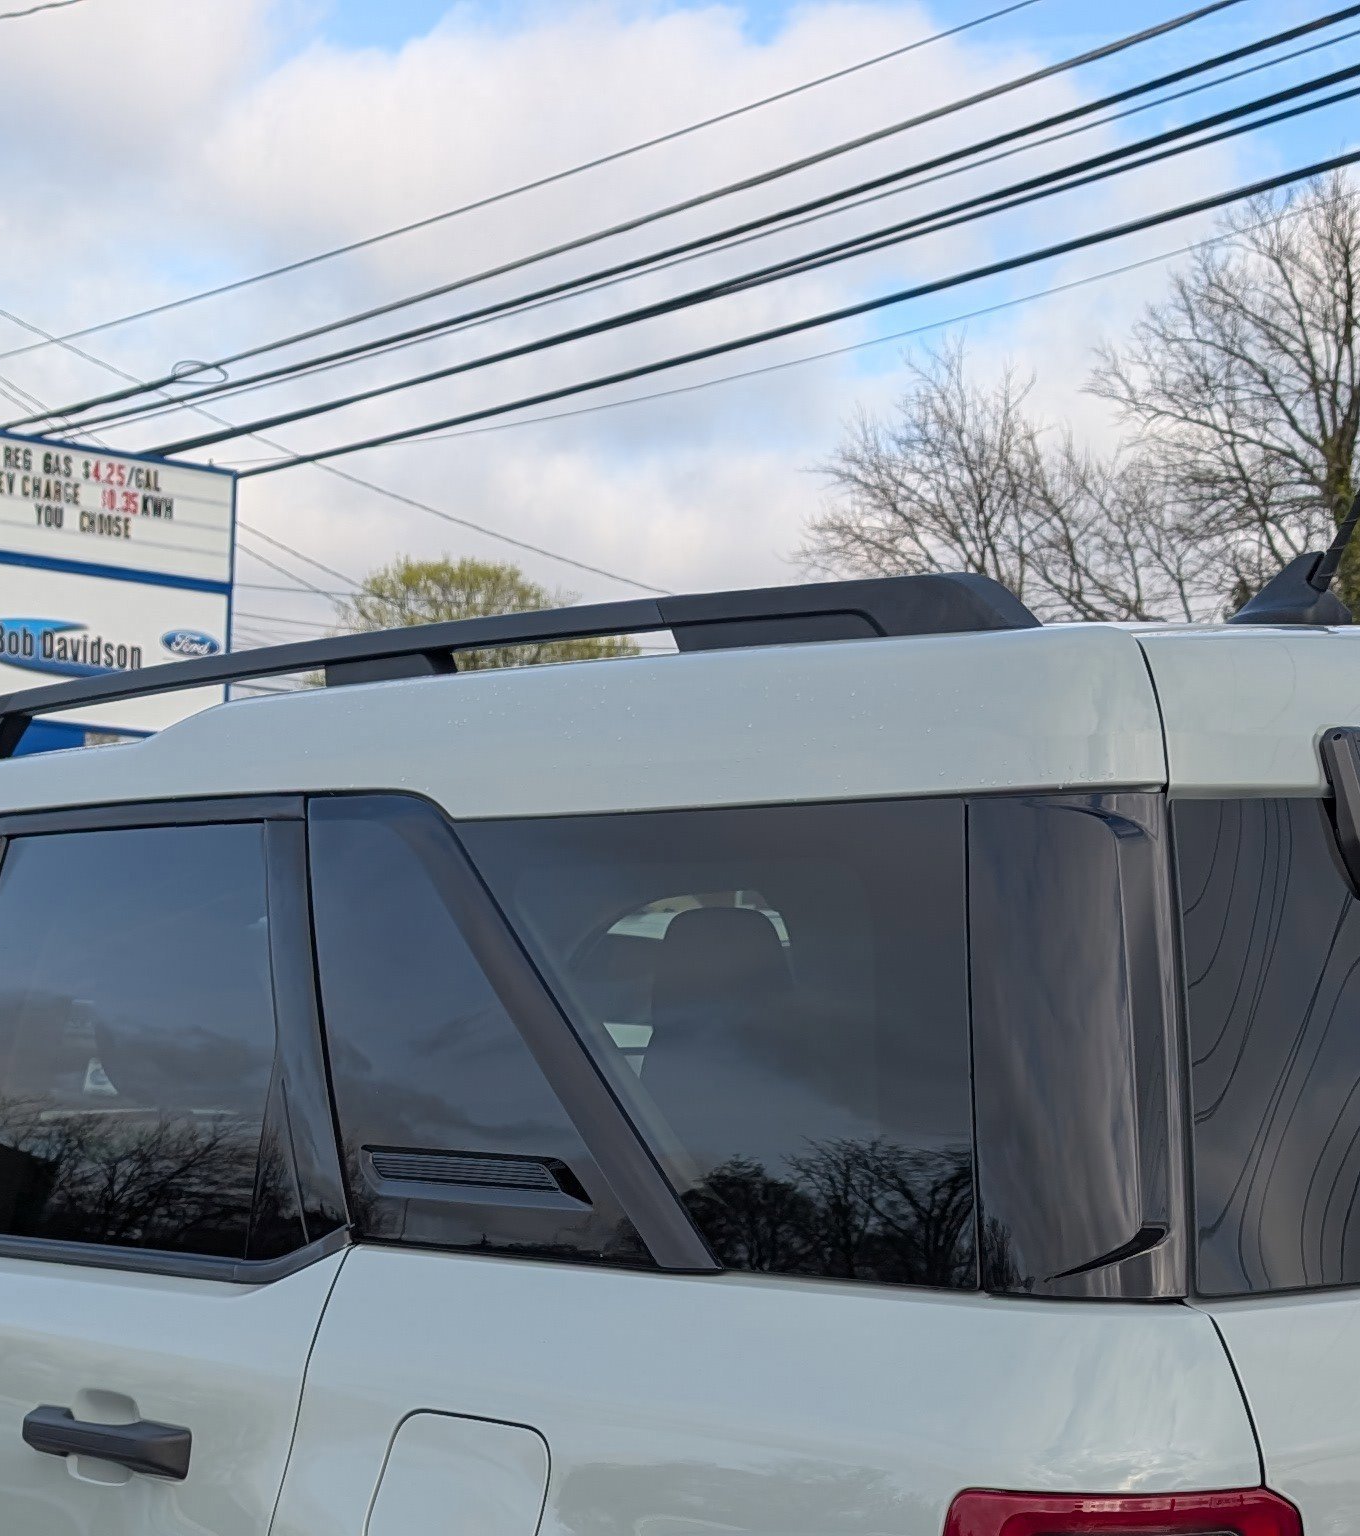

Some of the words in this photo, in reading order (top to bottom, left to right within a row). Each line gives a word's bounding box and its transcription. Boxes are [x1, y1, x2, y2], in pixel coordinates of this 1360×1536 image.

[3, 446, 32, 471] REG
[43, 451, 73, 477] GAS
[22, 475, 80, 505] CHARGE
[142, 494, 174, 519] KWH
[34, 503, 63, 528] YOU
[79, 510, 132, 539] CHOOSE
[42, 630, 142, 670] Davidson
